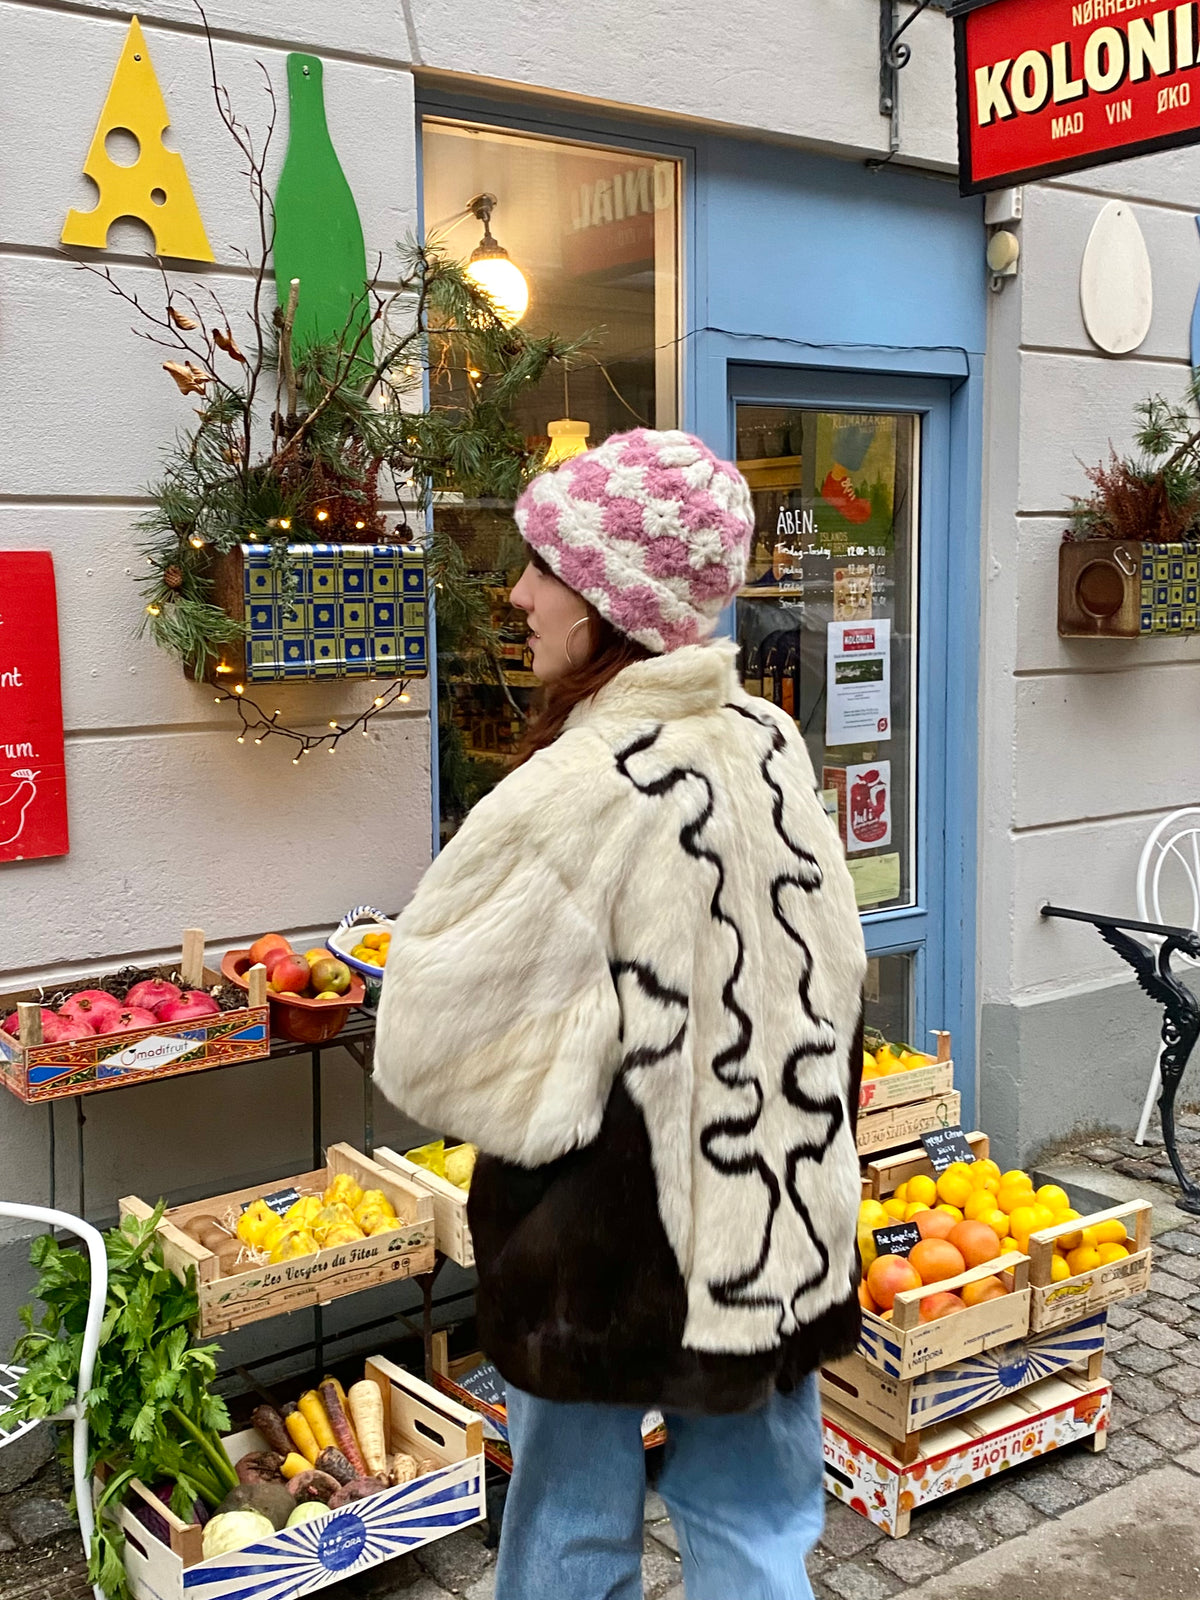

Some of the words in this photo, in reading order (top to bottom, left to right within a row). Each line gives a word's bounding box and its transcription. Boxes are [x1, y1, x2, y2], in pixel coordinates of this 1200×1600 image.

[974, 2, 1200, 126] KOLONI
[1051, 112, 1084, 139] MAD
[1105, 99, 1132, 125] VIN
[1156, 83, 1191, 113] ØKO
[776, 506, 818, 535] ÅBEN:
[262, 1273, 281, 1287] Les
[286, 1261, 328, 1280] Vergers
[332, 1254, 346, 1267] du
[349, 1247, 379, 1263] Fitou
